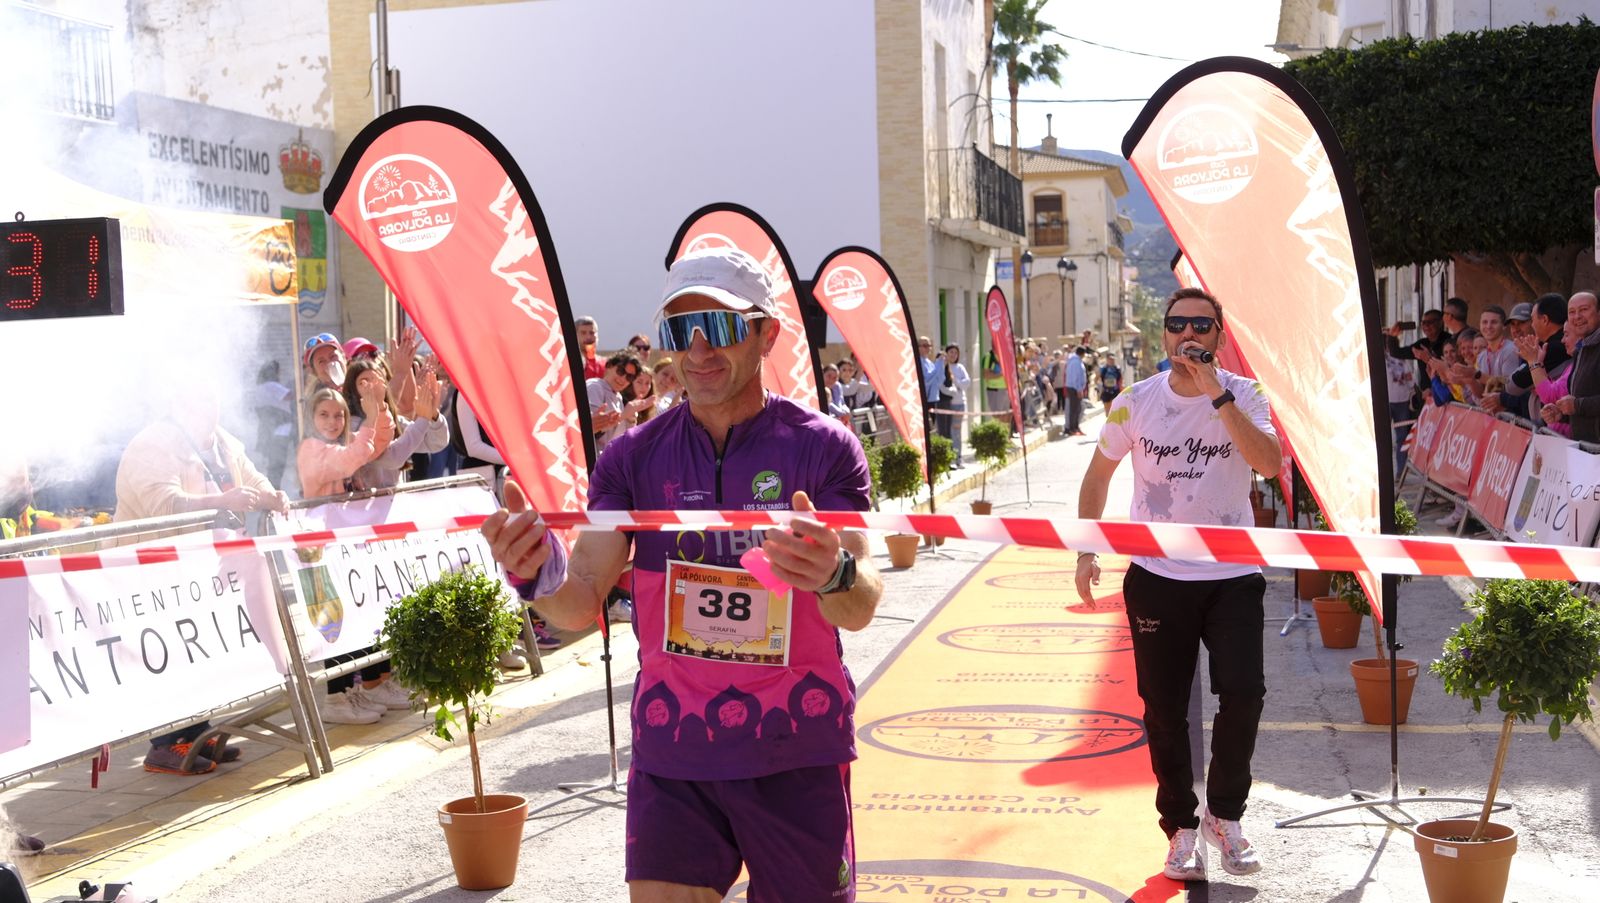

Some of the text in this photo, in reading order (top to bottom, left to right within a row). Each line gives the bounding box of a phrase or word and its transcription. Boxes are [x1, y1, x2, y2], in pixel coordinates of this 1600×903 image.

[148, 132, 270, 175] EXCELENTÍSIMO
[1138, 436, 1181, 466] Pepe
[1165, 467, 1205, 483] speaker
[743, 503, 756, 511] LOS
[211, 571, 241, 597] DE
[698, 588, 752, 621] 38
[871, 792, 1082, 804] de Cantoria
[1026, 887, 1088, 899] LA
